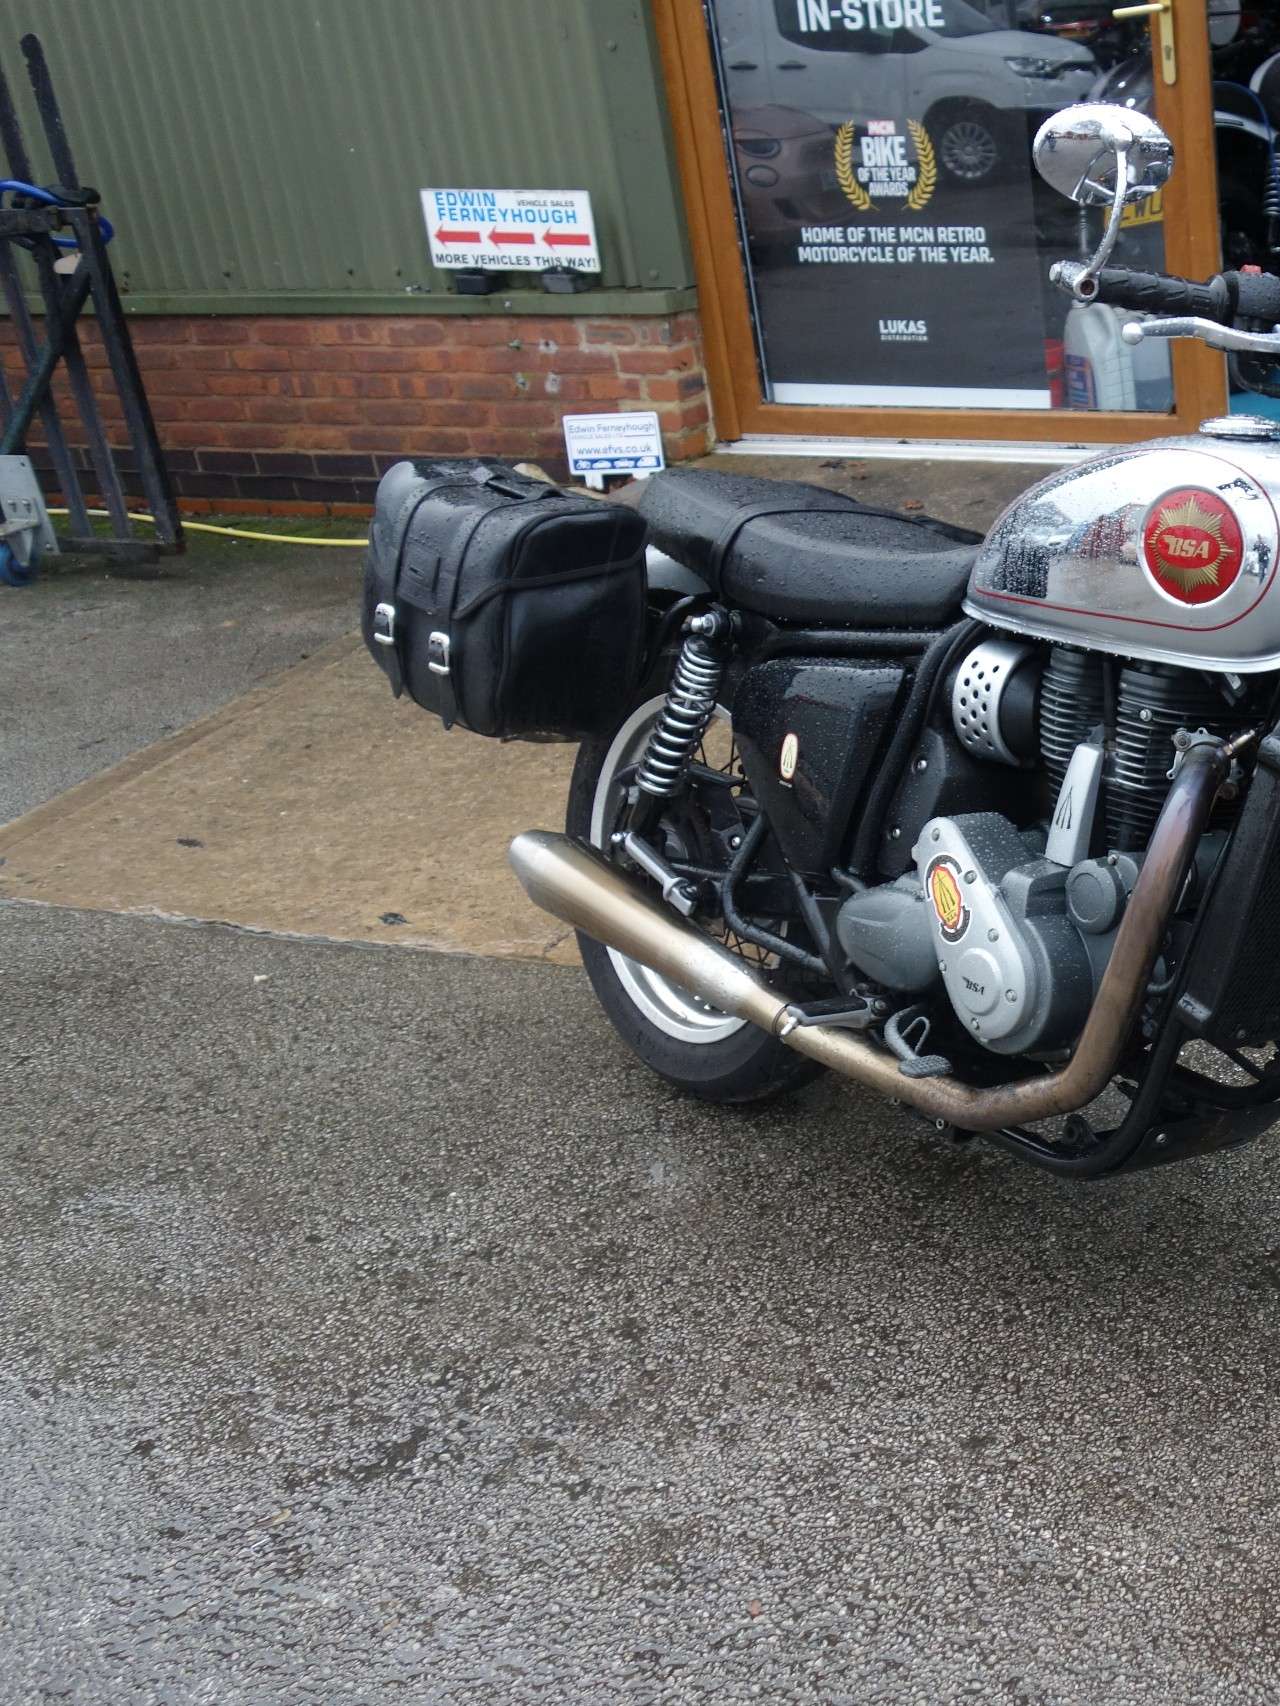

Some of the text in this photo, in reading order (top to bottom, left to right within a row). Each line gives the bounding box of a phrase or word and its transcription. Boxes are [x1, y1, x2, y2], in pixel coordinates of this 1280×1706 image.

[797, 0, 945, 31] IN-STORE
[861, 136, 908, 167] BIKE
[858, 166, 916, 182] OF THE YEAR
[869, 181, 908, 196] AWARDS
[435, 192, 496, 207] EDWIN
[517, 199, 548, 207] VEHICLE
[438, 207, 577, 224] FERNEYHOUGH
[801, 227, 986, 243] HOME OF THE MCN RETRO
[434, 253, 597, 268] MORE VEHICLES THIS WAY!
[798, 246, 995, 263] MOTORCYCLE OF THE YEAR.
[879, 319, 927, 334] LUKAS
[568, 421, 655, 434] Edwin Ferneyhough
